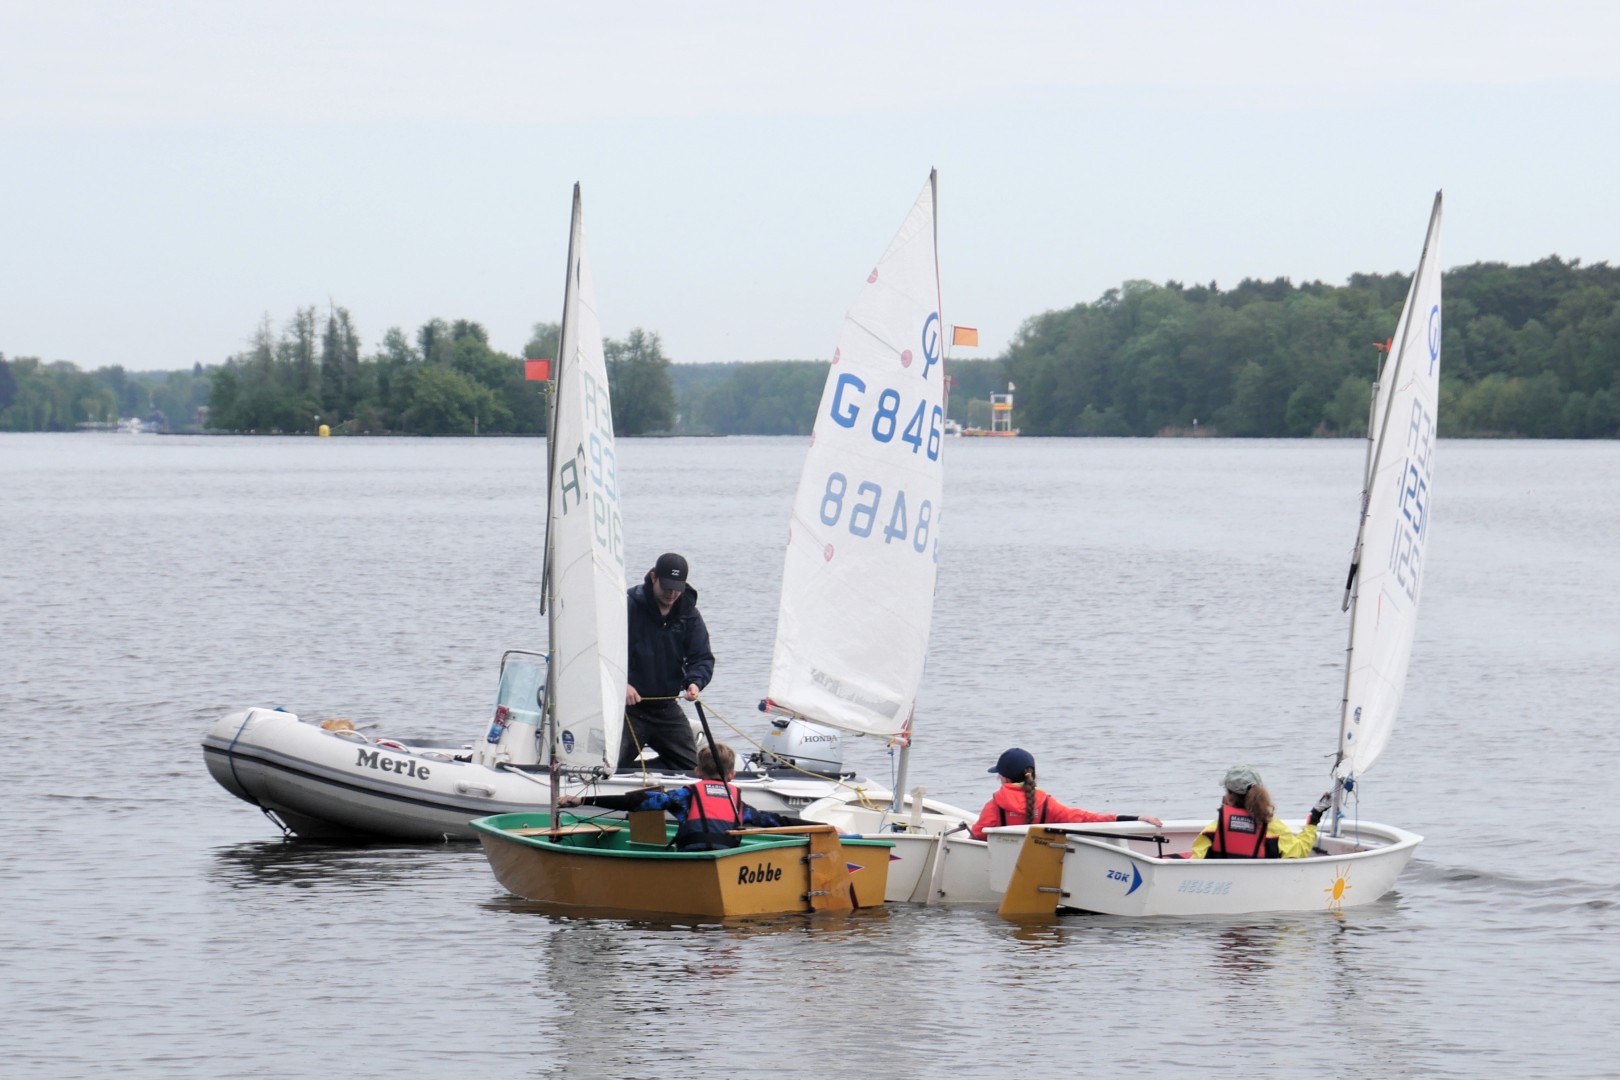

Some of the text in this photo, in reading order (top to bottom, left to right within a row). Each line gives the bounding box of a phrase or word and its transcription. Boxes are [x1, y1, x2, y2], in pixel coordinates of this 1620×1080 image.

[829, 372, 867, 429] G
[804, 734, 838, 743] HONDA
[355, 747, 431, 781] Merle
[737, 862, 783, 886] Robbe
